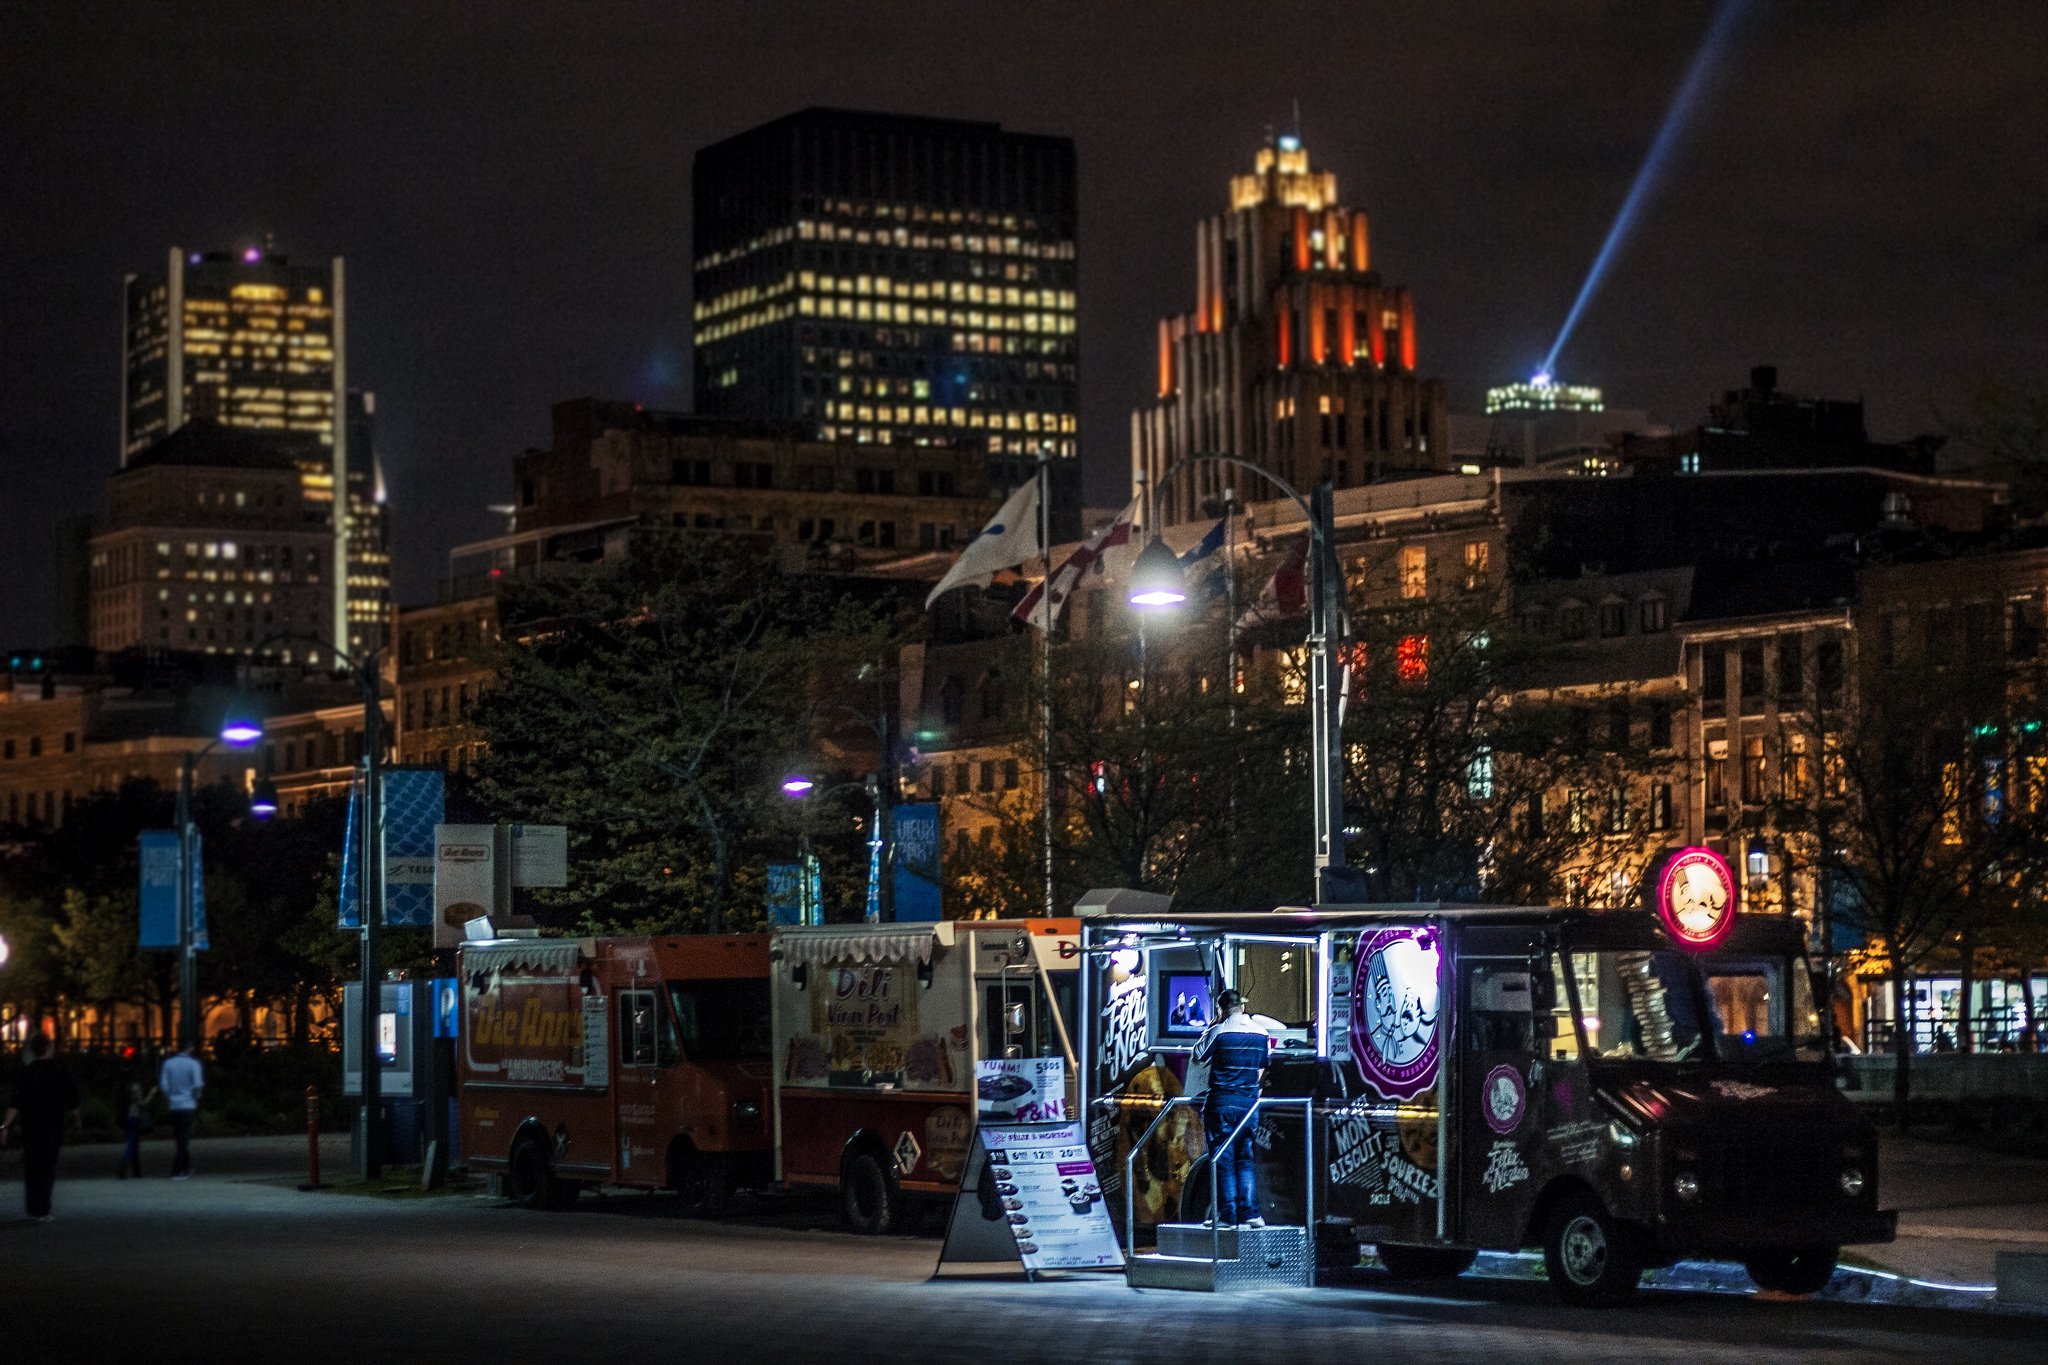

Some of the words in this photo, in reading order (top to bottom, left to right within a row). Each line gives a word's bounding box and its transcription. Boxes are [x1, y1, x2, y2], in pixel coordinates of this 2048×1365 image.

[1329, 1129, 1383, 1184] BISCUIT
[1334, 1114, 1371, 1156] MON
[1380, 1150, 1438, 1199] SOURIEZ
